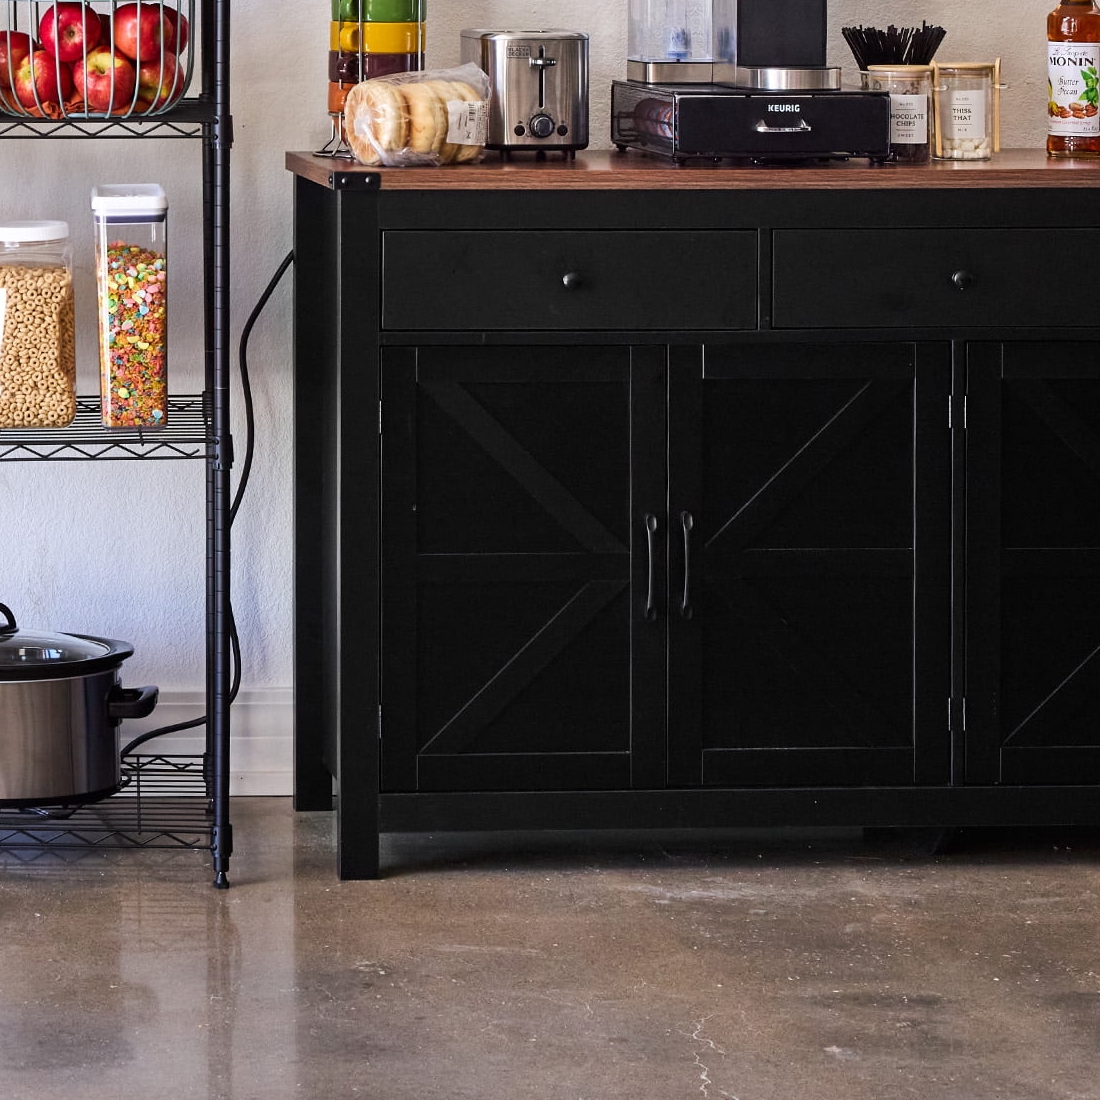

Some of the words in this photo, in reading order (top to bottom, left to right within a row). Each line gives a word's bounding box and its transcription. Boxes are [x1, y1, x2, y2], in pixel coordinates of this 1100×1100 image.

[1050, 57, 1093, 66] MONIN
[1058, 75, 1079, 85] Butter
[767, 104, 800, 112] KEURIG
